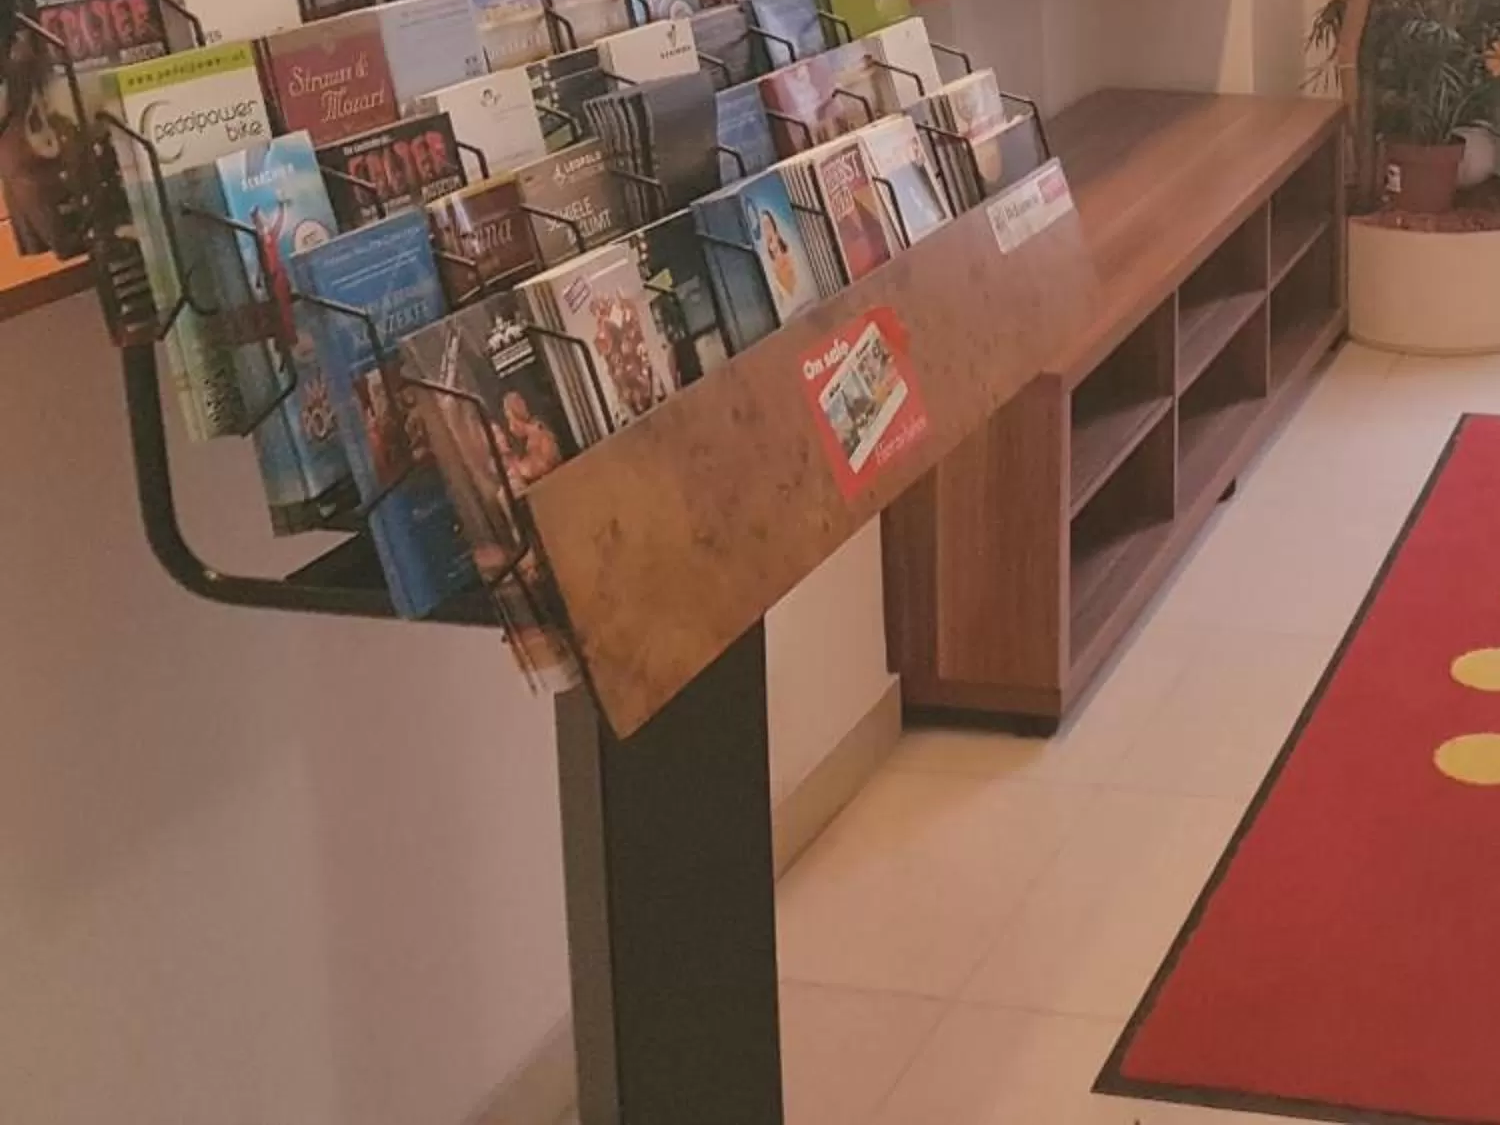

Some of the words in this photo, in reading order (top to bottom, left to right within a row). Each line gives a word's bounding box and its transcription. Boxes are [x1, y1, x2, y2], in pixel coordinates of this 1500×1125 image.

[288, 65, 352, 97] Strauss
[320, 84, 385, 124] Mozart
[225, 120, 264, 143] bike
